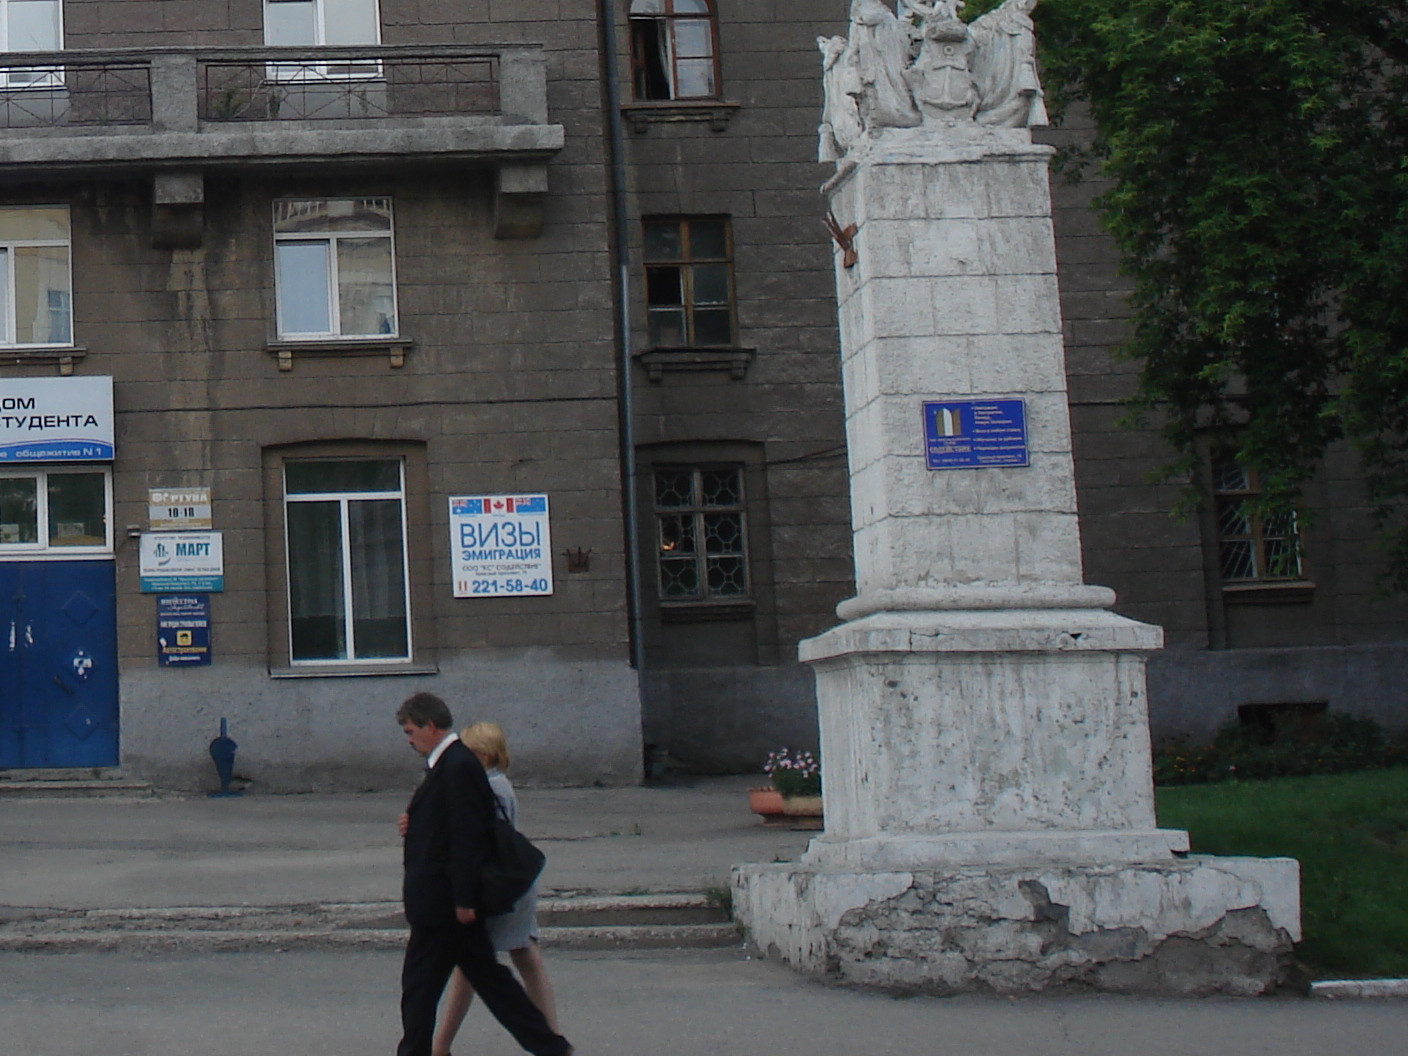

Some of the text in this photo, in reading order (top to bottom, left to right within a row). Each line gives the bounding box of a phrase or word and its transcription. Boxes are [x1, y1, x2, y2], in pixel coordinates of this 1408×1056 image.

[15, 448, 82, 459] общежитие
[95, 447, 102, 456] 1
[460, 521, 541, 549] ВИЗЫ
[176, 543, 210, 557] МАРТ
[461, 548, 541, 561] ЭМИГРАЦИЯ
[472, 578, 548, 594] 221-58-40
